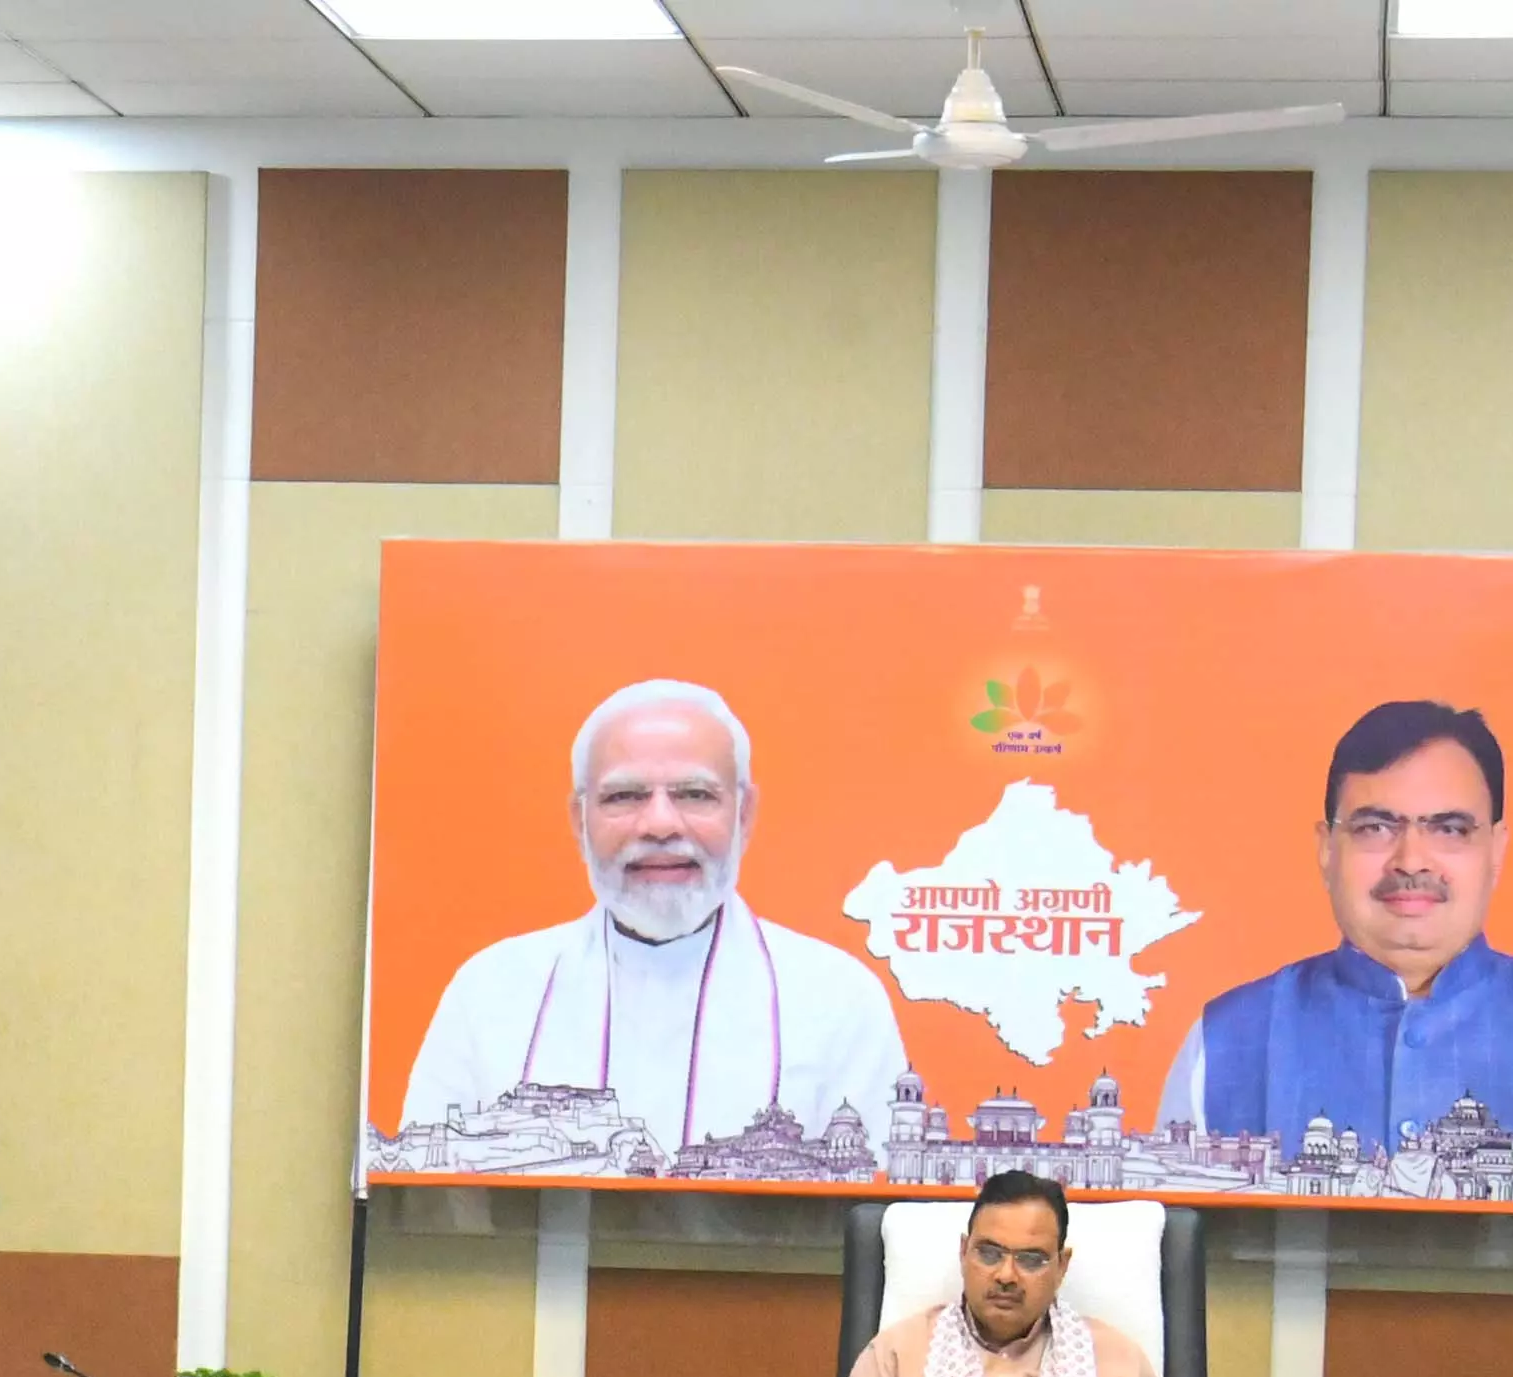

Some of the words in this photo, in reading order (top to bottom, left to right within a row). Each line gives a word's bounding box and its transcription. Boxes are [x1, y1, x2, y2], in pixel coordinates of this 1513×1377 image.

[901, 878, 1001, 911] आपणो
[1014, 882, 1112, 913] अग्रणी
[890, 912, 1124, 956] राजस्थान
